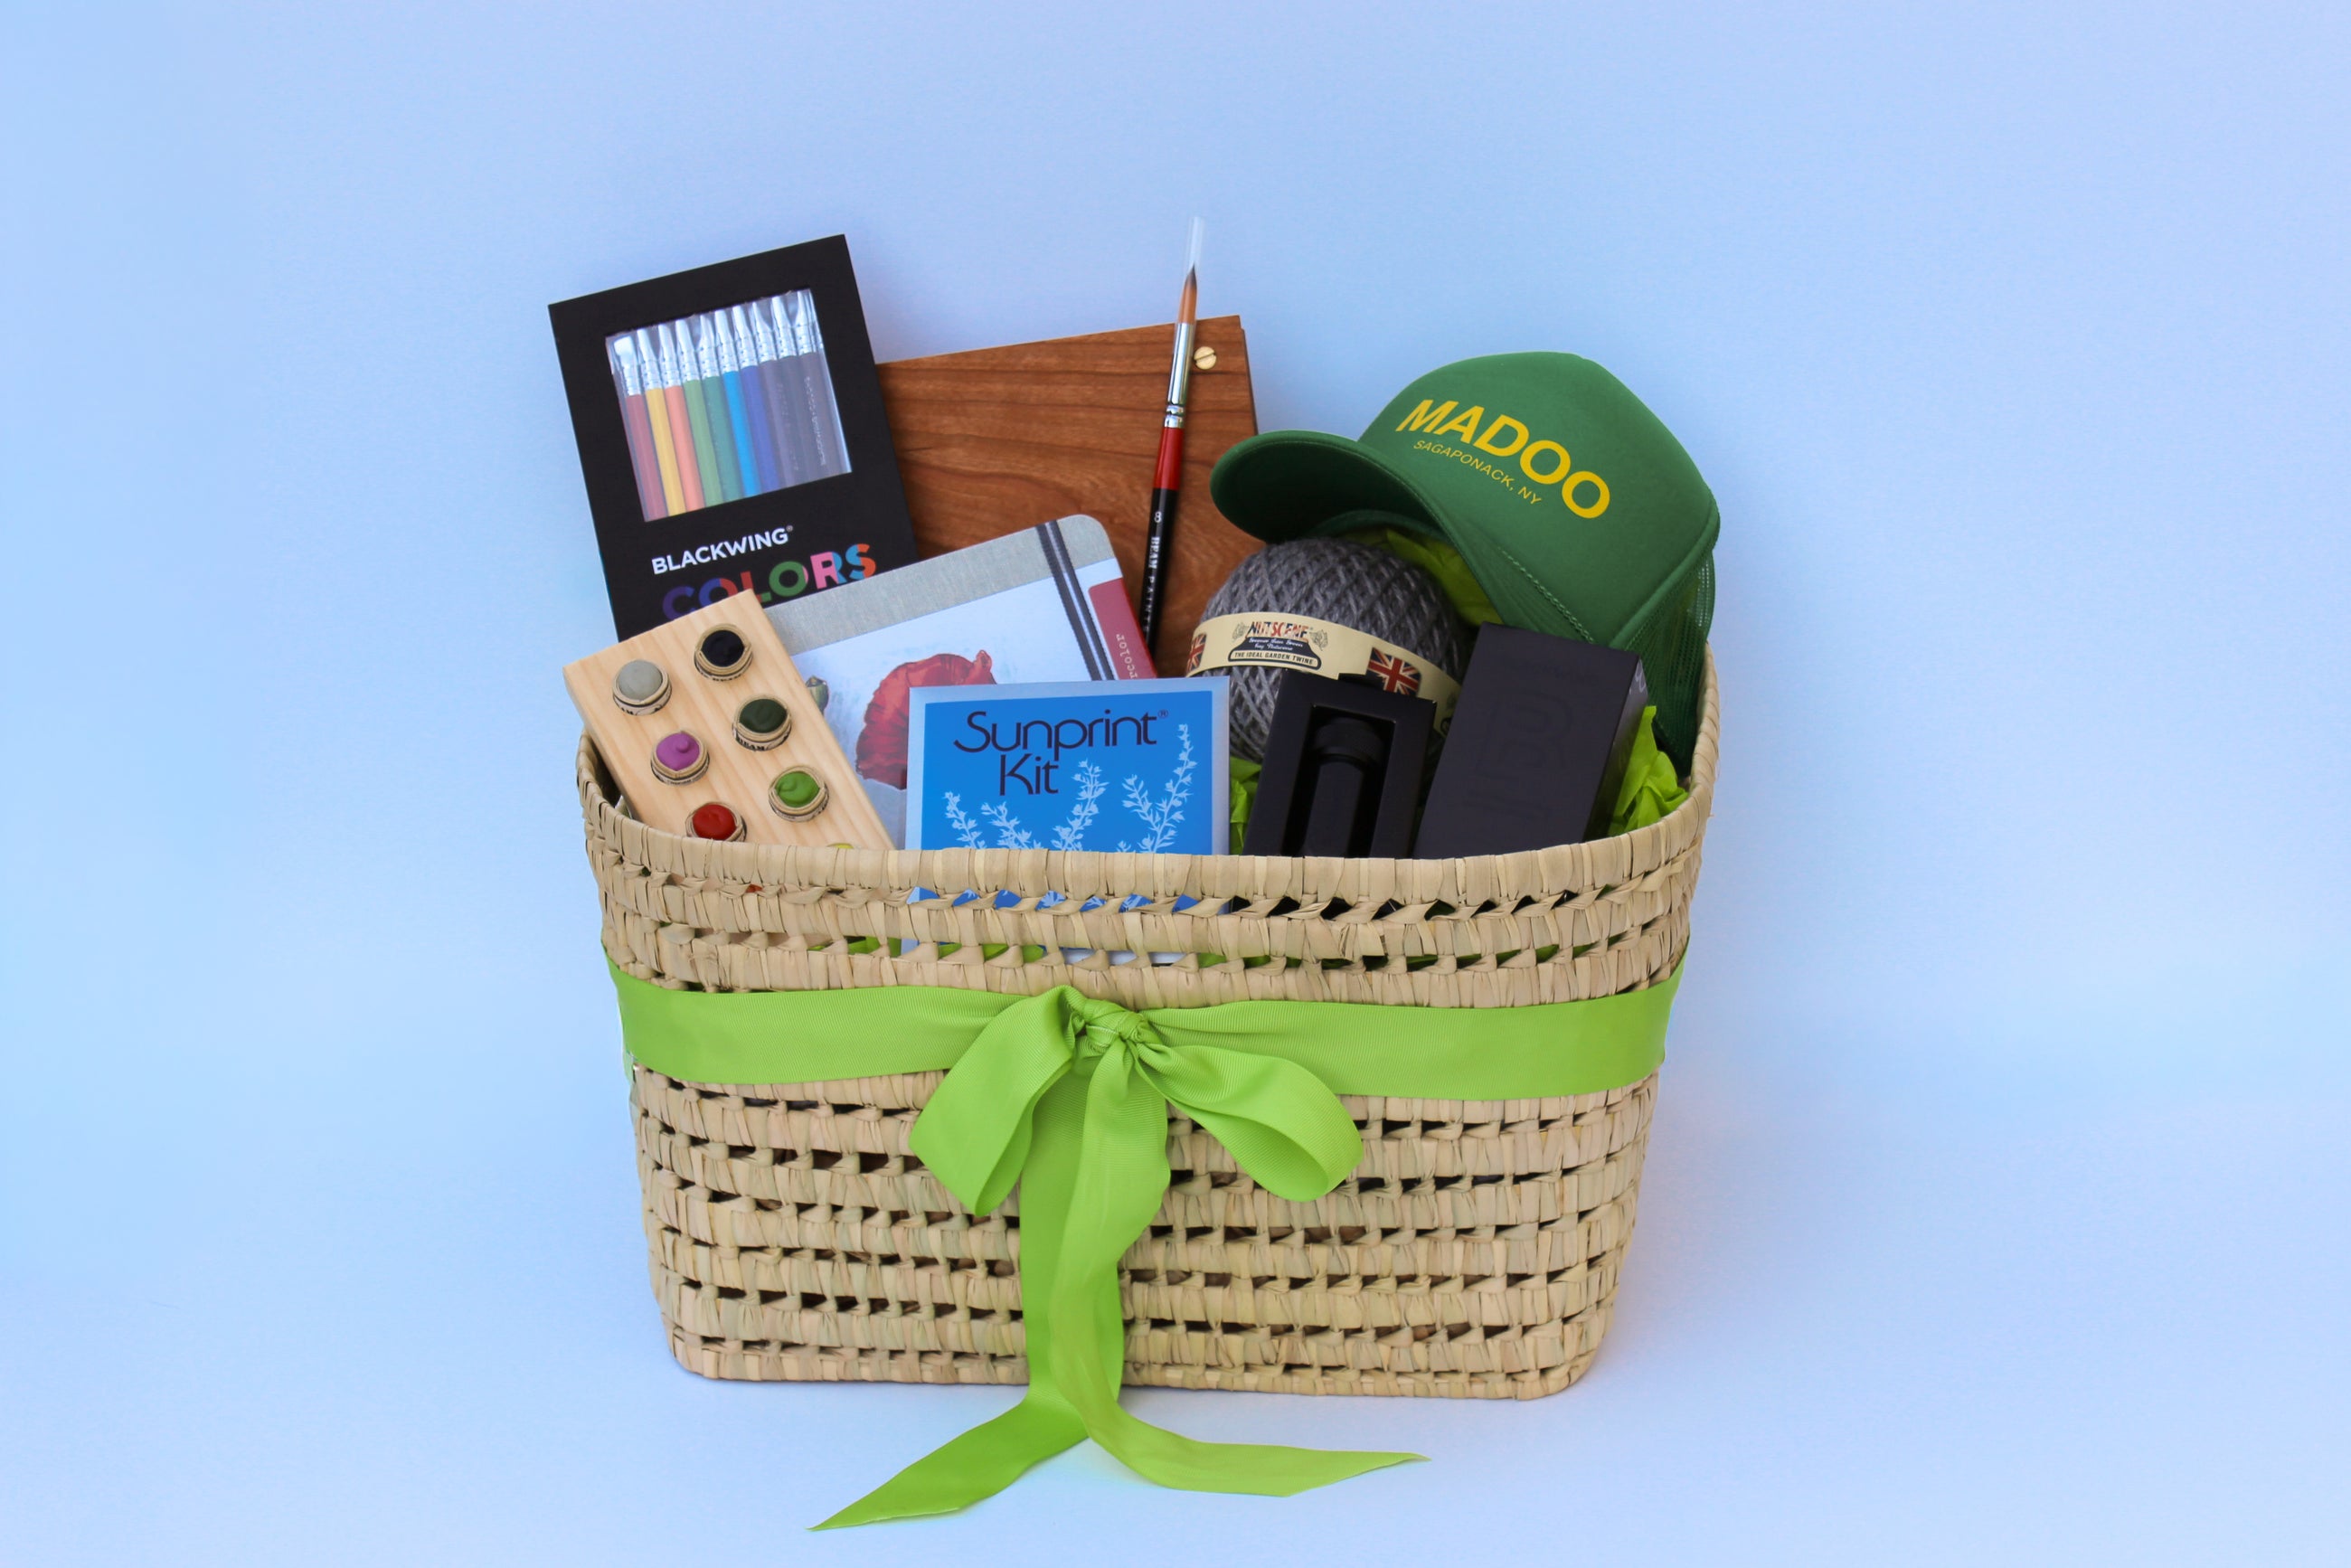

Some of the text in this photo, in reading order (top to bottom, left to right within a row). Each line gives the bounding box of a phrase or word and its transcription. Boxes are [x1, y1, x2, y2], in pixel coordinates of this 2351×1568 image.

[1395, 399, 1610, 519] MADOO
[1413, 439, 1542, 505] SAGAPONACK, NY
[1154, 511, 1162, 524] 8
[651, 526, 789, 575] BLACKWING
[1116, 633, 1138, 679] rcolor
[1265, 652, 1290, 660] GARDEN
[1292, 656, 1314, 666] TWINE
[999, 753, 1059, 797] Kit
